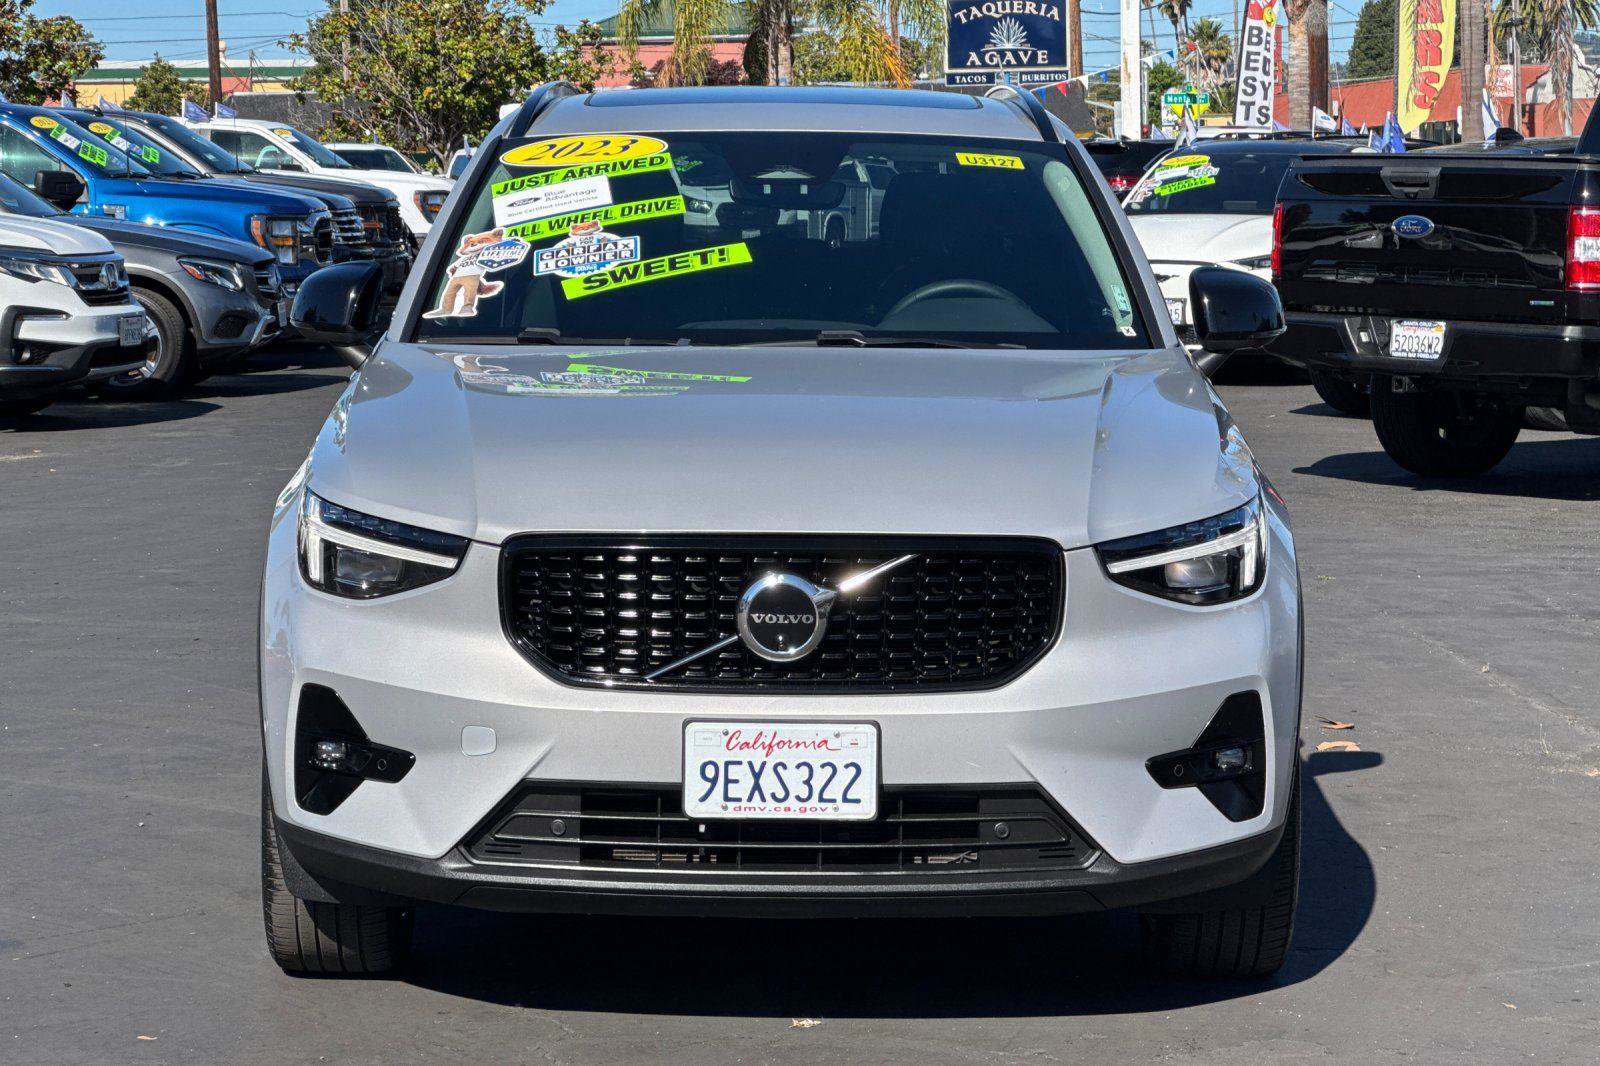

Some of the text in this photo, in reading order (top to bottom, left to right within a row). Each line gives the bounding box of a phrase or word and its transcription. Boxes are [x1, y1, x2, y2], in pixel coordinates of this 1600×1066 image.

[954, 1, 1060, 24] TAQUERIA
[966, 50, 1049, 66] AGAVE
[955, 75, 987, 83] TACOS
[1021, 73, 1067, 81] BURRITOS
[1240, 25, 1264, 121] BEST
[523, 138, 639, 162] 2023
[965, 156, 1015, 167] U3127
[496, 155, 666, 195] JUST ARRIVED
[544, 189, 566, 197] Blue
[545, 189, 597, 203] Advantage
[508, 198, 678, 239] ALL WHEEL DRIVE
[541, 241, 631, 260] CARFAX
[557, 250, 631, 267] OWNER
[582, 247, 729, 290] SWEET!
[1395, 334, 1440, 354] 52036W2
[751, 613, 814, 625] VOLVO
[725, 730, 842, 757] California
[698, 760, 862, 804] 9EXS322
[733, 804, 829, 813] dmv.ca.gov
